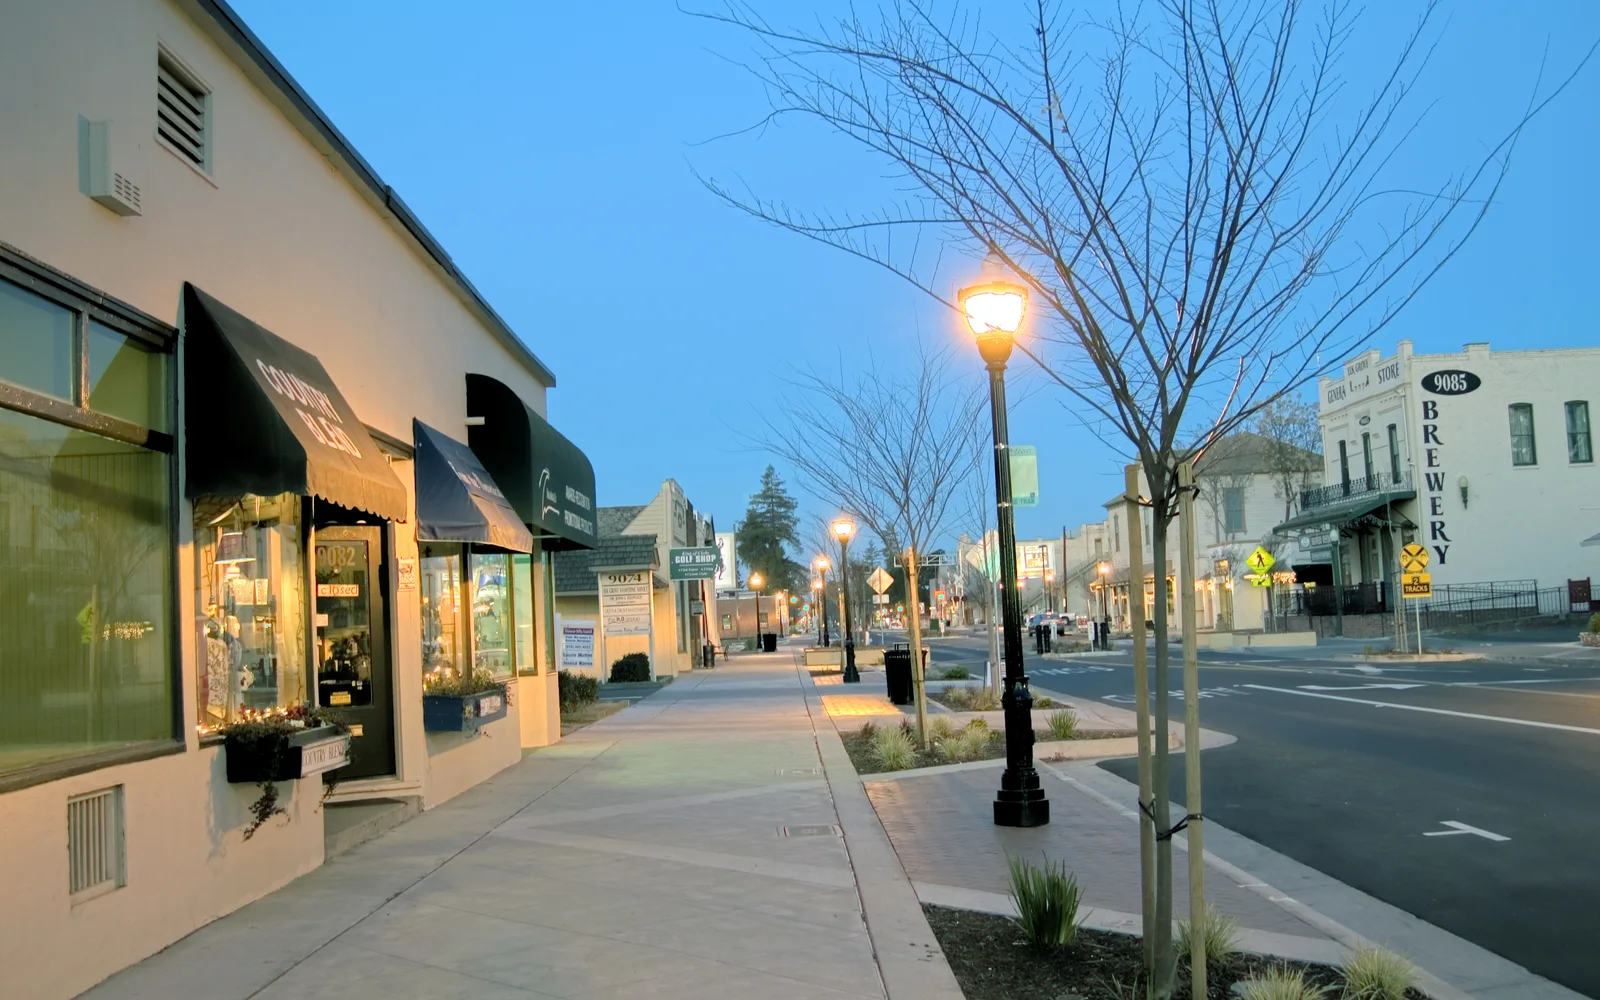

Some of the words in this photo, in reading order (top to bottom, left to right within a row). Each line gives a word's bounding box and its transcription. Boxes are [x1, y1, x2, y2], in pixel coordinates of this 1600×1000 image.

[1347, 366, 1356, 376] ELK
[1377, 362, 1400, 384] STORE
[1434, 373, 1467, 391] 9085
[256, 358, 343, 424] COUNTRY
[295, 407, 362, 459] BLEND
[1422, 400, 1452, 565] BREWERY
[317, 546, 356, 567] 9082
[675, 556, 693, 564] GOLF
[696, 554, 716, 563] SHOP
[1402, 554, 1408, 562] R
[608, 573, 642, 583] 9074
[1413, 577, 1419, 585] 2
[320, 585, 358, 595] closed
[328, 744, 344, 760] BLEND
